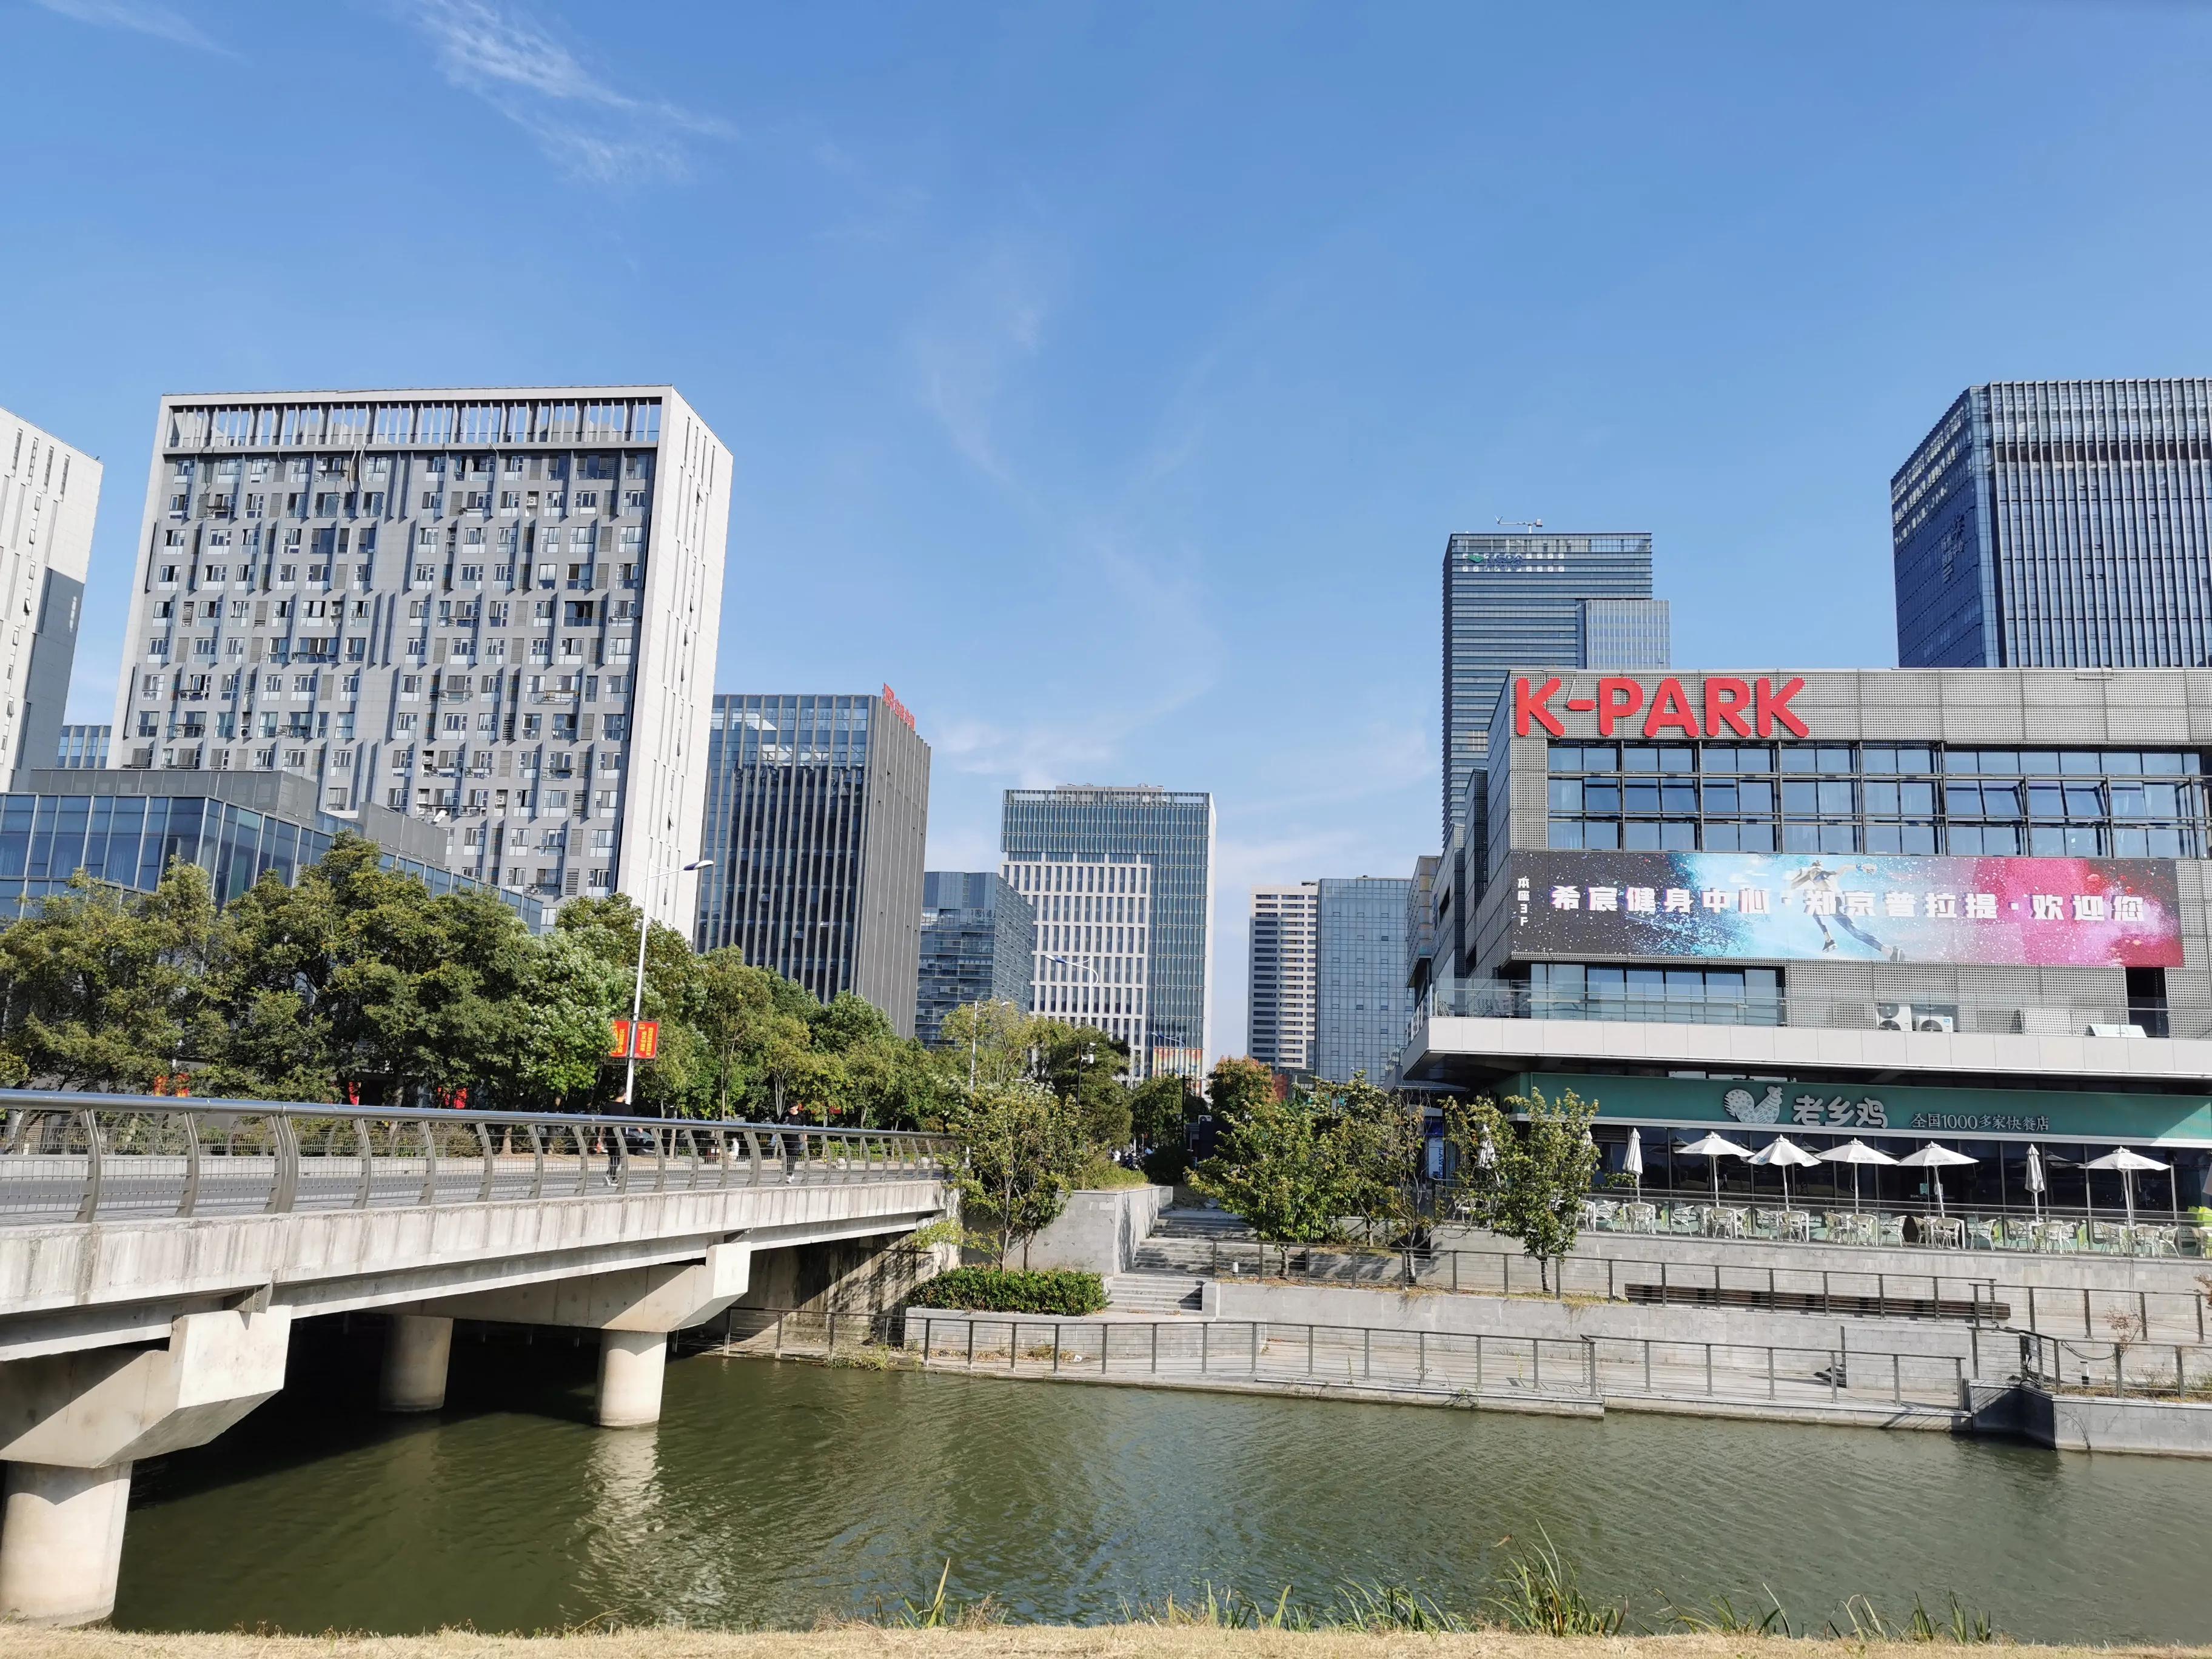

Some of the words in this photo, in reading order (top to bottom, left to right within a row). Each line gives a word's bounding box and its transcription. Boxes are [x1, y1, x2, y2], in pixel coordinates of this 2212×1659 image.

[1516, 677, 1810, 738] K-PARK
[1518, 877, 1530, 926] 本座3F
[1793, 1094, 1888, 1129] 老乡鸡
[1911, 1113, 2049, 1131] 全国1000多家快餐店
